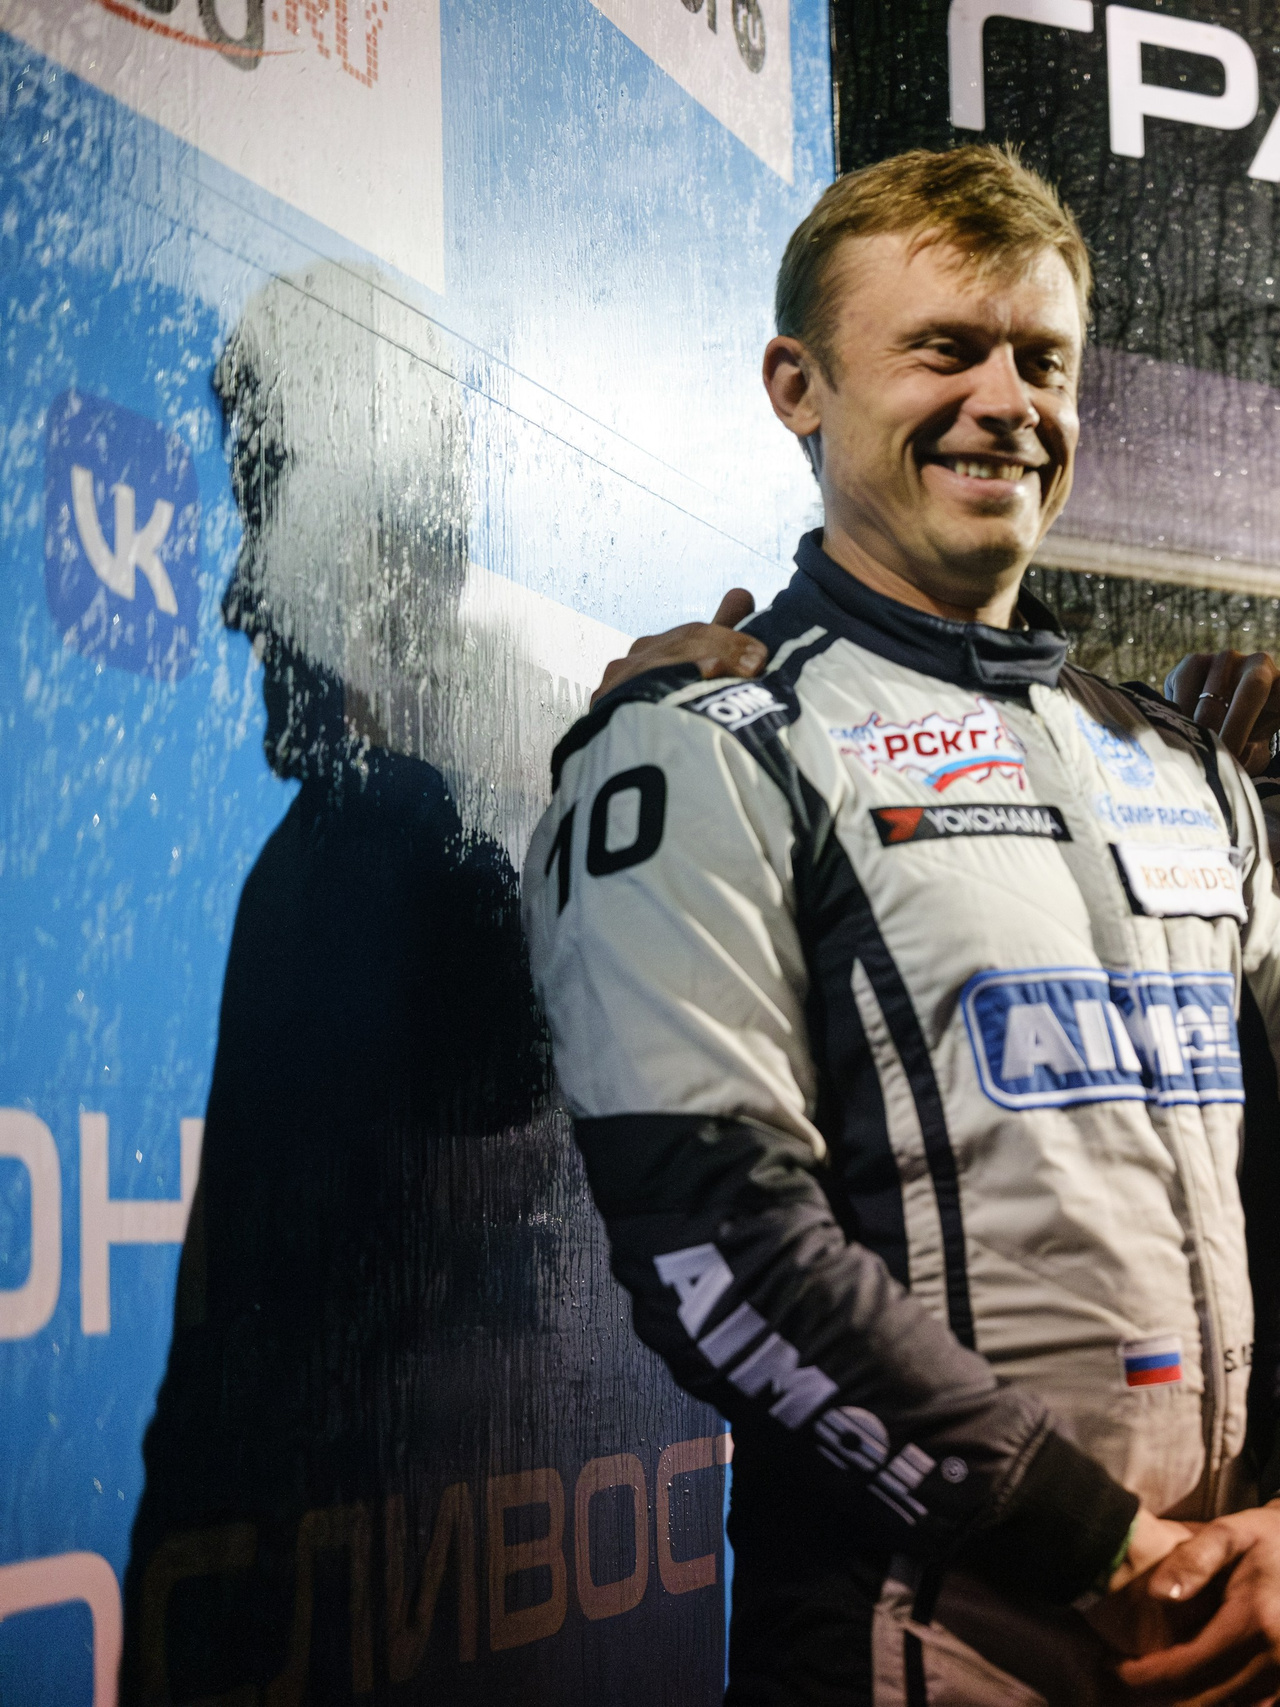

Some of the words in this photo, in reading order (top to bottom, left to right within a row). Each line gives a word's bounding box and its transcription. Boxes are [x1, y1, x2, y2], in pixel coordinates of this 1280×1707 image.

[71, 463, 178, 617] VK
[883, 730, 987, 760] РСКГ
[545, 764, 666, 918] 10
[924, 807, 1063, 834] YOKOHAMA
